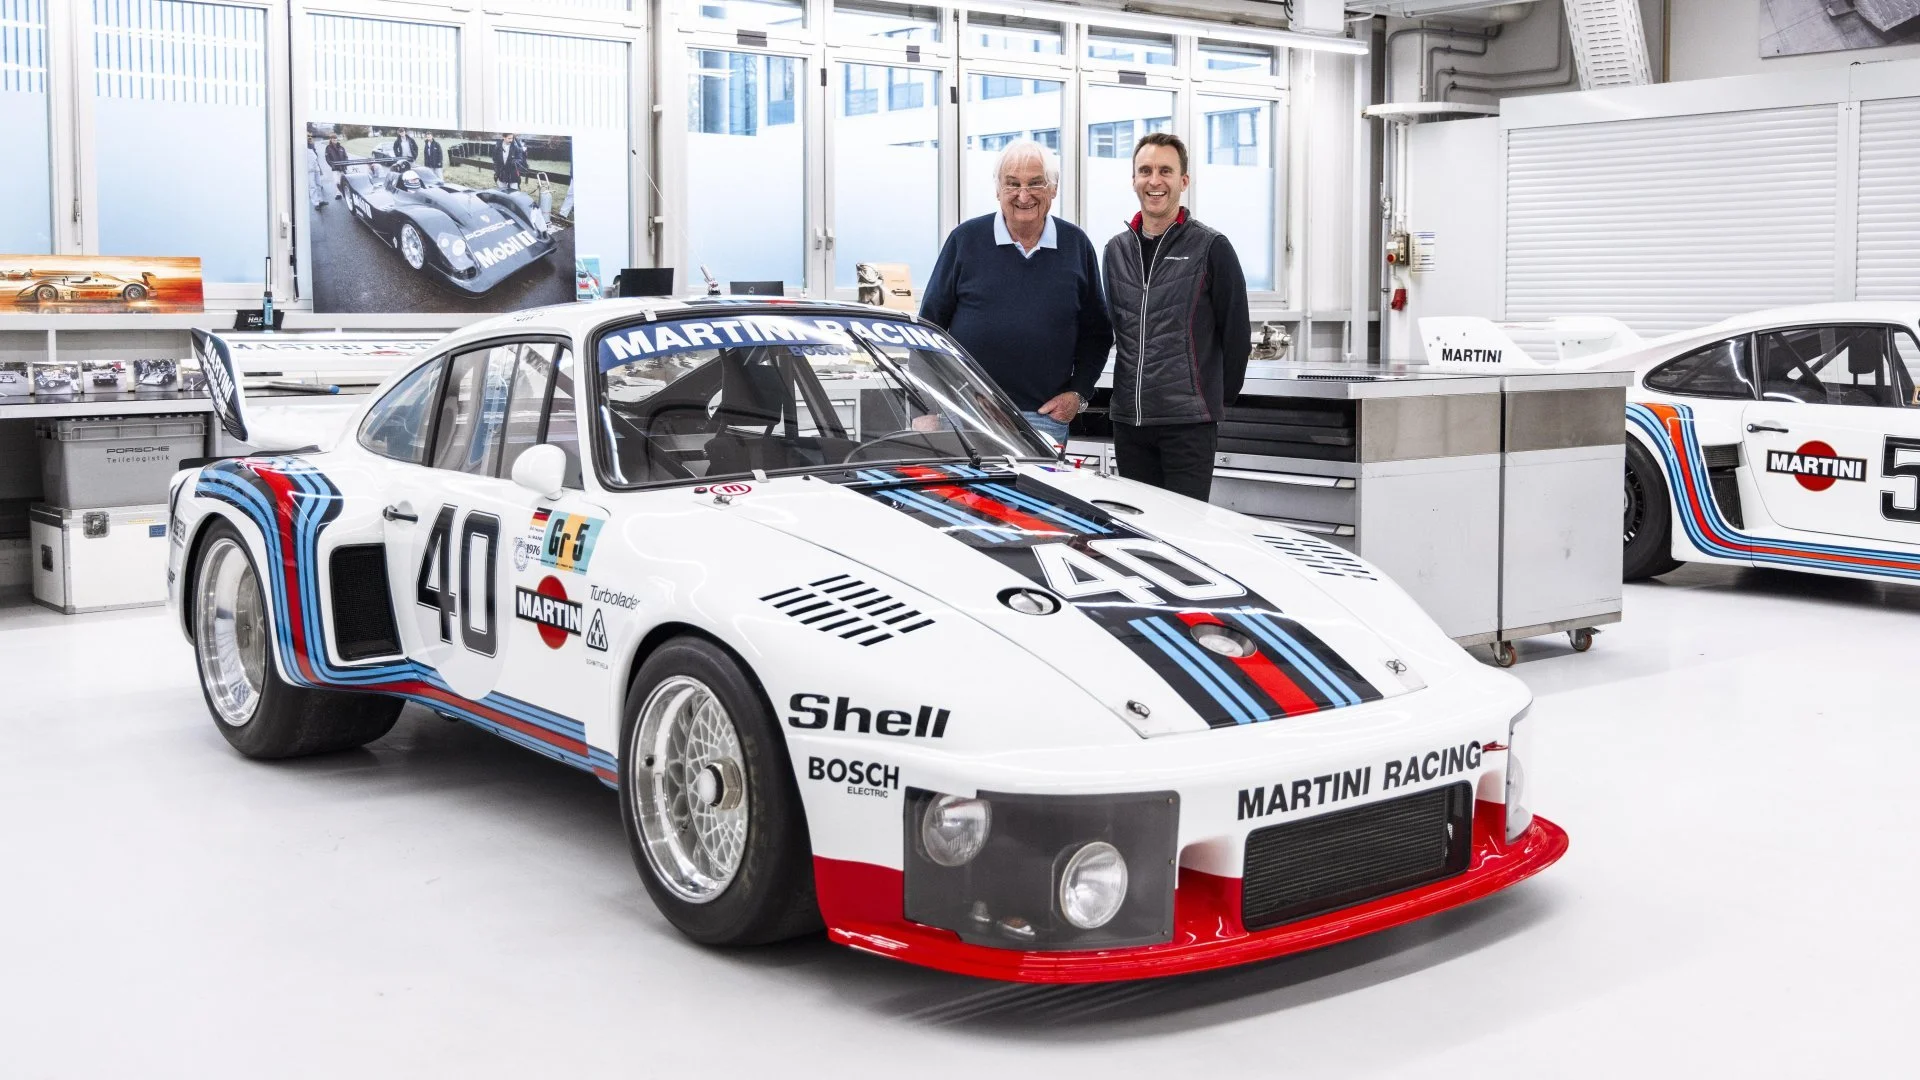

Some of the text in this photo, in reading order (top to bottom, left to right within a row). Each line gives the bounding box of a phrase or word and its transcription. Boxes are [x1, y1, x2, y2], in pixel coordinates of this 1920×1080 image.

[464, 219, 516, 240] PORSCHE
[474, 235, 525, 268] Mobil
[605, 317, 965, 361] MARTINI RACING
[1442, 348, 1502, 363] MARTINI
[204, 335, 235, 404] MARTINI
[106, 446, 170, 454] PORSCHE
[106, 455, 170, 463] Teilelogistik
[1770, 452, 1863, 480] MARTINI
[526, 543, 541, 556] 1976
[548, 518, 571, 558] Gr
[572, 522, 591, 562] 5
[416, 502, 501, 659] 40
[1031, 537, 1248, 606] 40
[788, 692, 951, 738] Shell
[808, 756, 900, 790] BOSCH
[1237, 740, 1481, 820] MARTINI RACING
[847, 785, 888, 799] ELECTRIC
